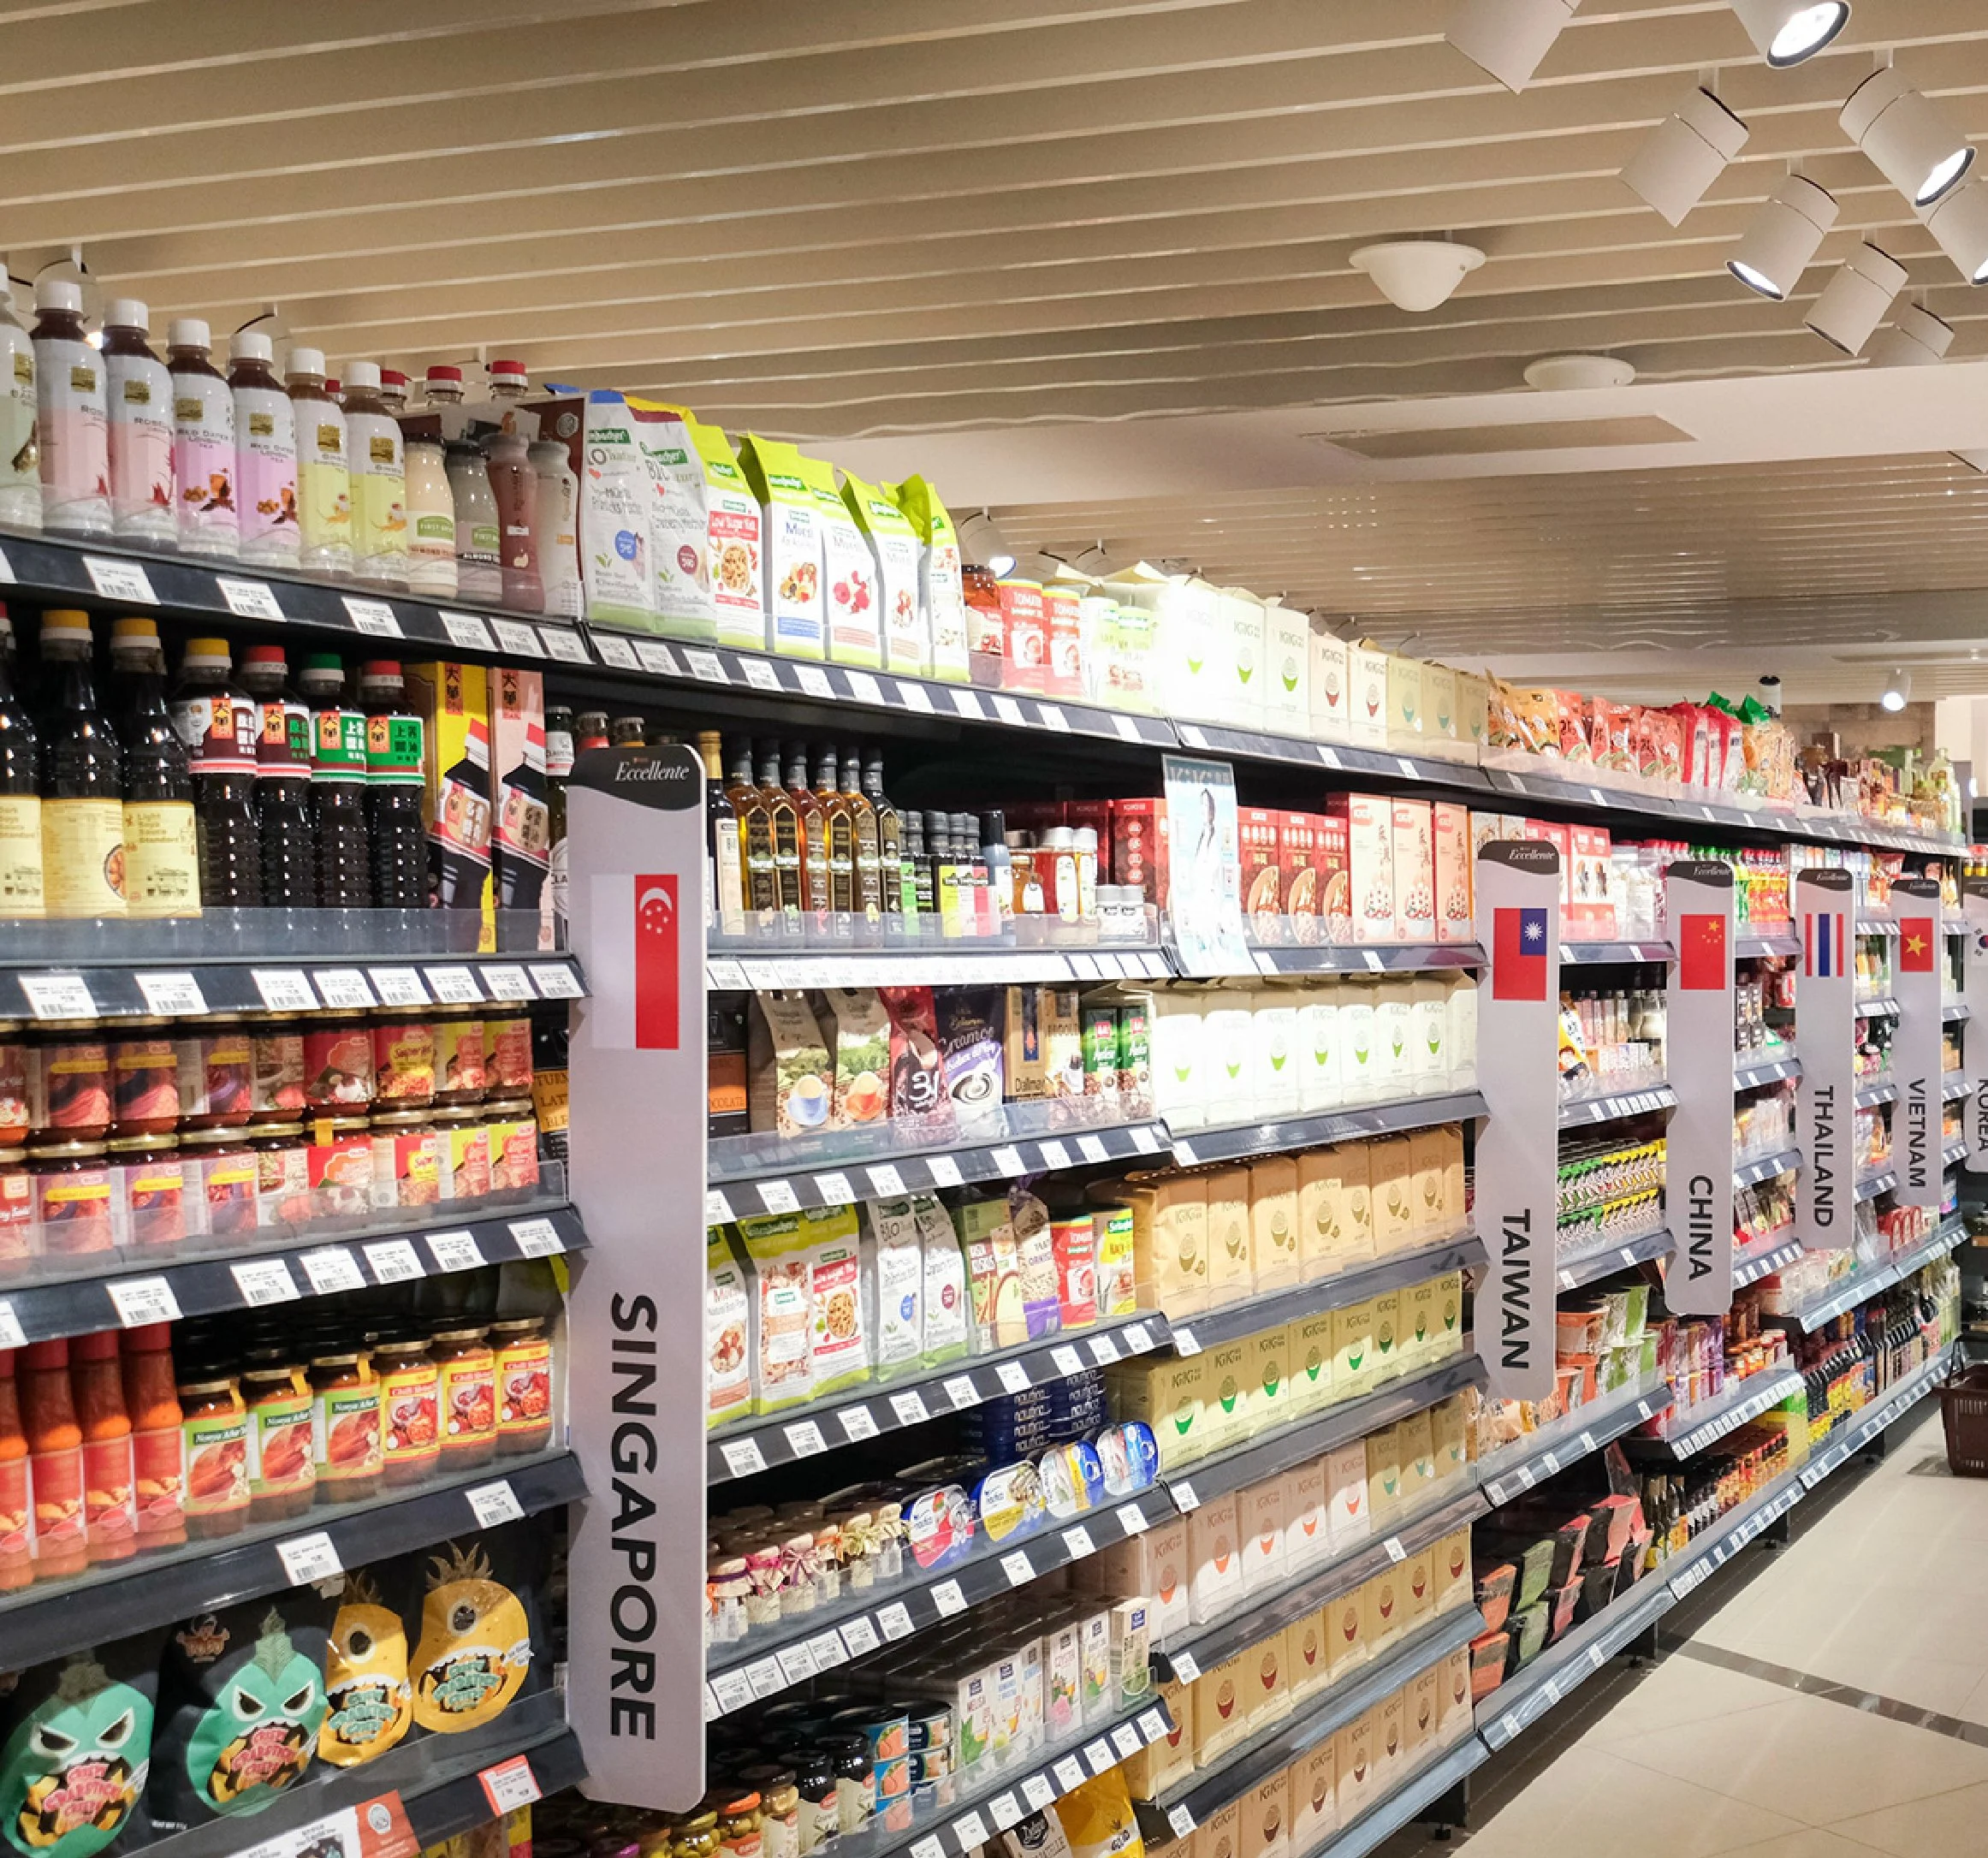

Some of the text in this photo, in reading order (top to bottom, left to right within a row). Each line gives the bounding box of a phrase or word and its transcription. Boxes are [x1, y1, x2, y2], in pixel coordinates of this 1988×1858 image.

[614, 761, 690, 782] Eccellente
[1509, 848, 1555, 861] Eccellente
[1813, 1084, 1834, 1227] THAILAND
[1908, 1077, 1926, 1187] VIETNAM
[1977, 1079, 1988, 1151] KOREA
[1688, 1175, 1712, 1280] CHINA
[1501, 1208, 1531, 1370] TAIWAN
[609, 1291, 658, 1741] SINGAPORE
